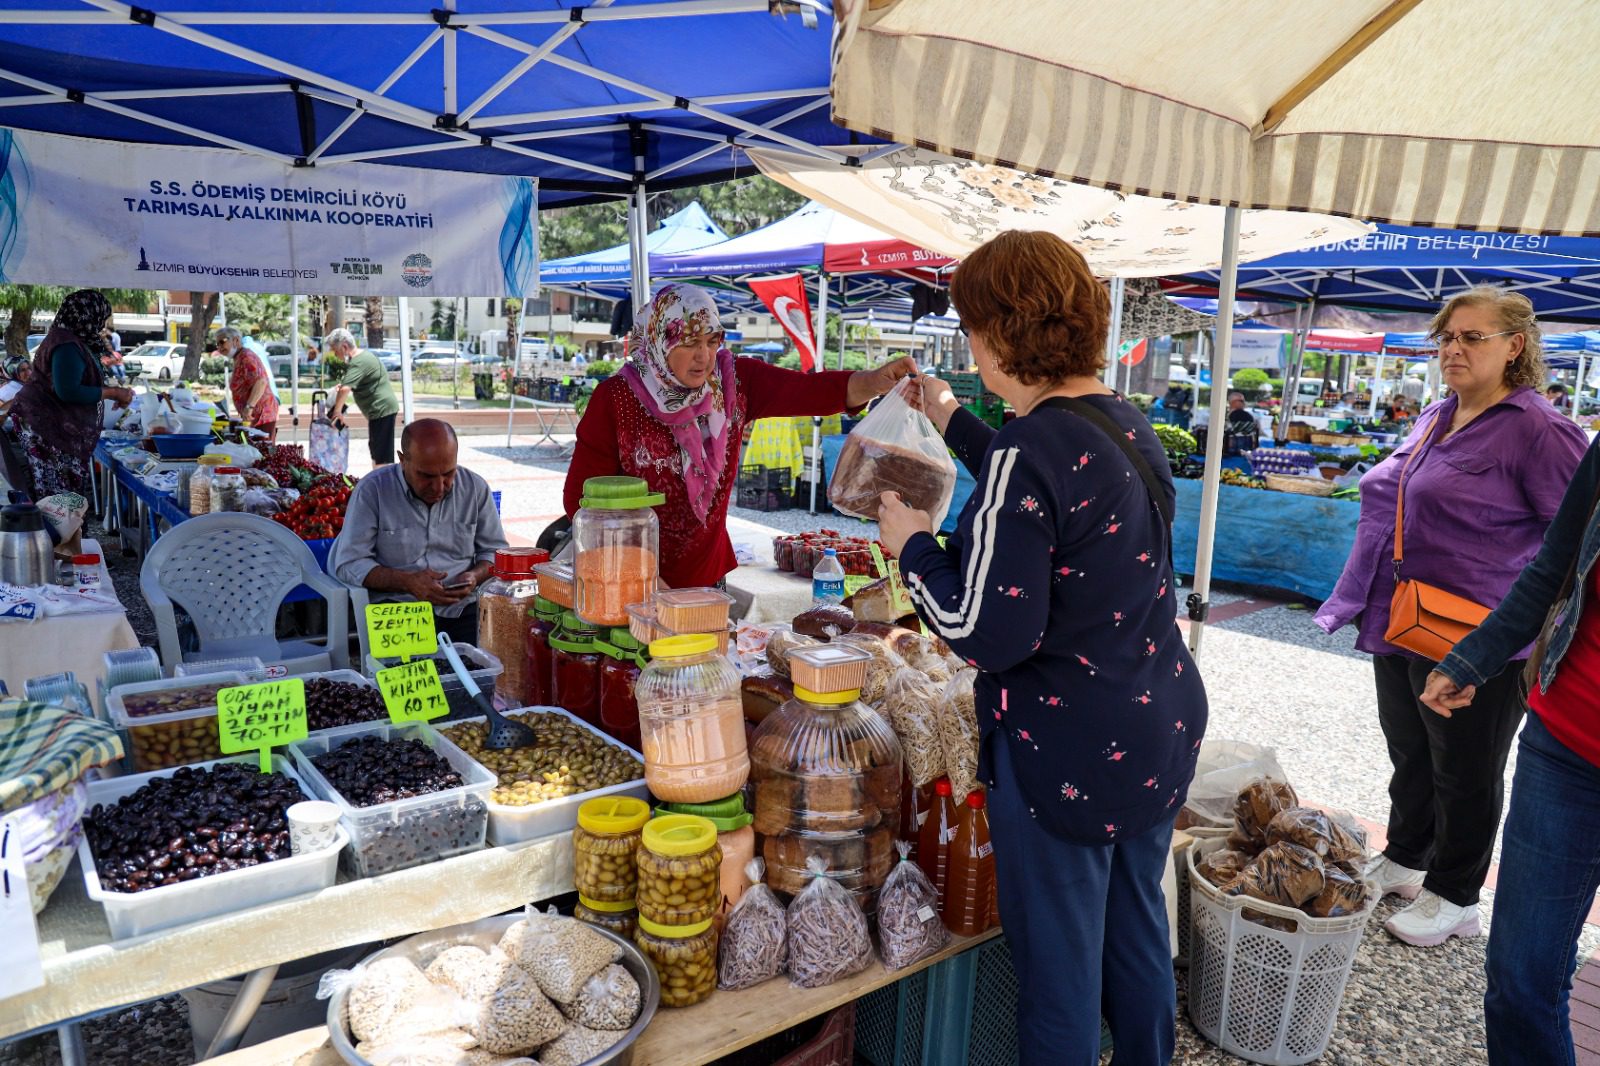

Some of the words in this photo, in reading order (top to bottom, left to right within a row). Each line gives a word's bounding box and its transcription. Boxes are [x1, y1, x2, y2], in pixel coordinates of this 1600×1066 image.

[150, 180, 187, 197] S.S.
[191, 180, 266, 203] ÖDEMİŞ
[270, 186, 357, 206] DEMİRCİLİ
[362, 191, 406, 209] KÖYÜ
[123, 197, 224, 217] TARIMSAL
[228, 204, 323, 224] KALKINMA
[326, 210, 433, 229] KOOPERATİFİ
[152, 261, 185, 273] İZMİR
[188, 263, 260, 277] BÜYÜKŞEHİR
[330, 262, 383, 275] TARIM
[404, 698, 423, 716] 60
[426, 694, 446, 710] TL
